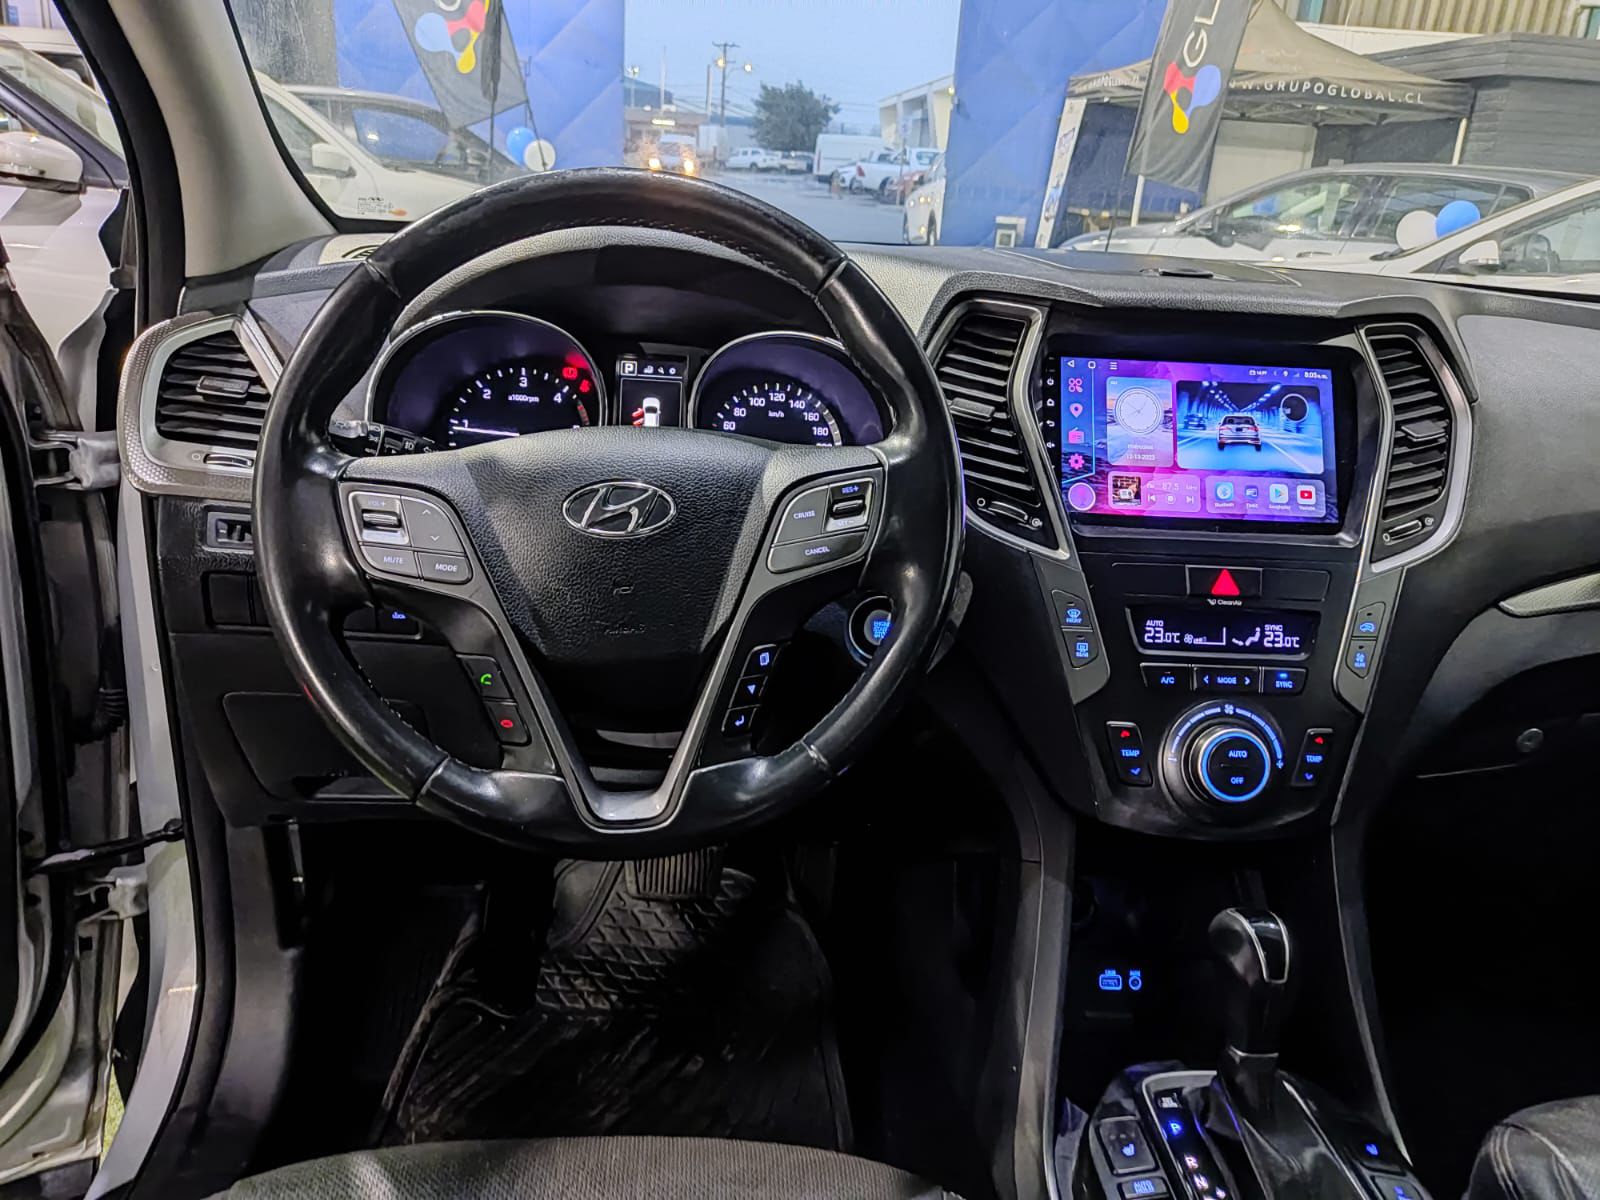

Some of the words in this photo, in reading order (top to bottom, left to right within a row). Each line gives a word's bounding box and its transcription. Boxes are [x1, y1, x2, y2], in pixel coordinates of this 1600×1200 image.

[518, 376, 529, 388] 3
[482, 388, 492, 400] 2
[553, 392, 563, 404] 4
[768, 392, 786, 402] 120
[749, 397, 766, 407] 100
[788, 400, 806, 409] 140
[733, 408, 747, 417] 80
[803, 412, 820, 421] 160
[723, 421, 736, 430] 60
[812, 427, 829, 436] 180
[793, 510, 816, 519] CRUISE
[804, 546, 830, 556] CANCEL
[383, 556, 403, 564] MUTE
[435, 563, 458, 572] MODE
[1264, 624, 1283, 632] SYNC
[1160, 676, 1175, 684] A/C
[1216, 676, 1237, 684] MODE
[1275, 681, 1293, 689] SYNC
[1121, 749, 1140, 757] TEMP
[1228, 750, 1248, 758] AUTO
[1230, 776, 1244, 784] OFF
[1169, 1121, 1182, 1136] P
[1184, 1154, 1199, 1169] R
[1193, 1174, 1209, 1190] N
